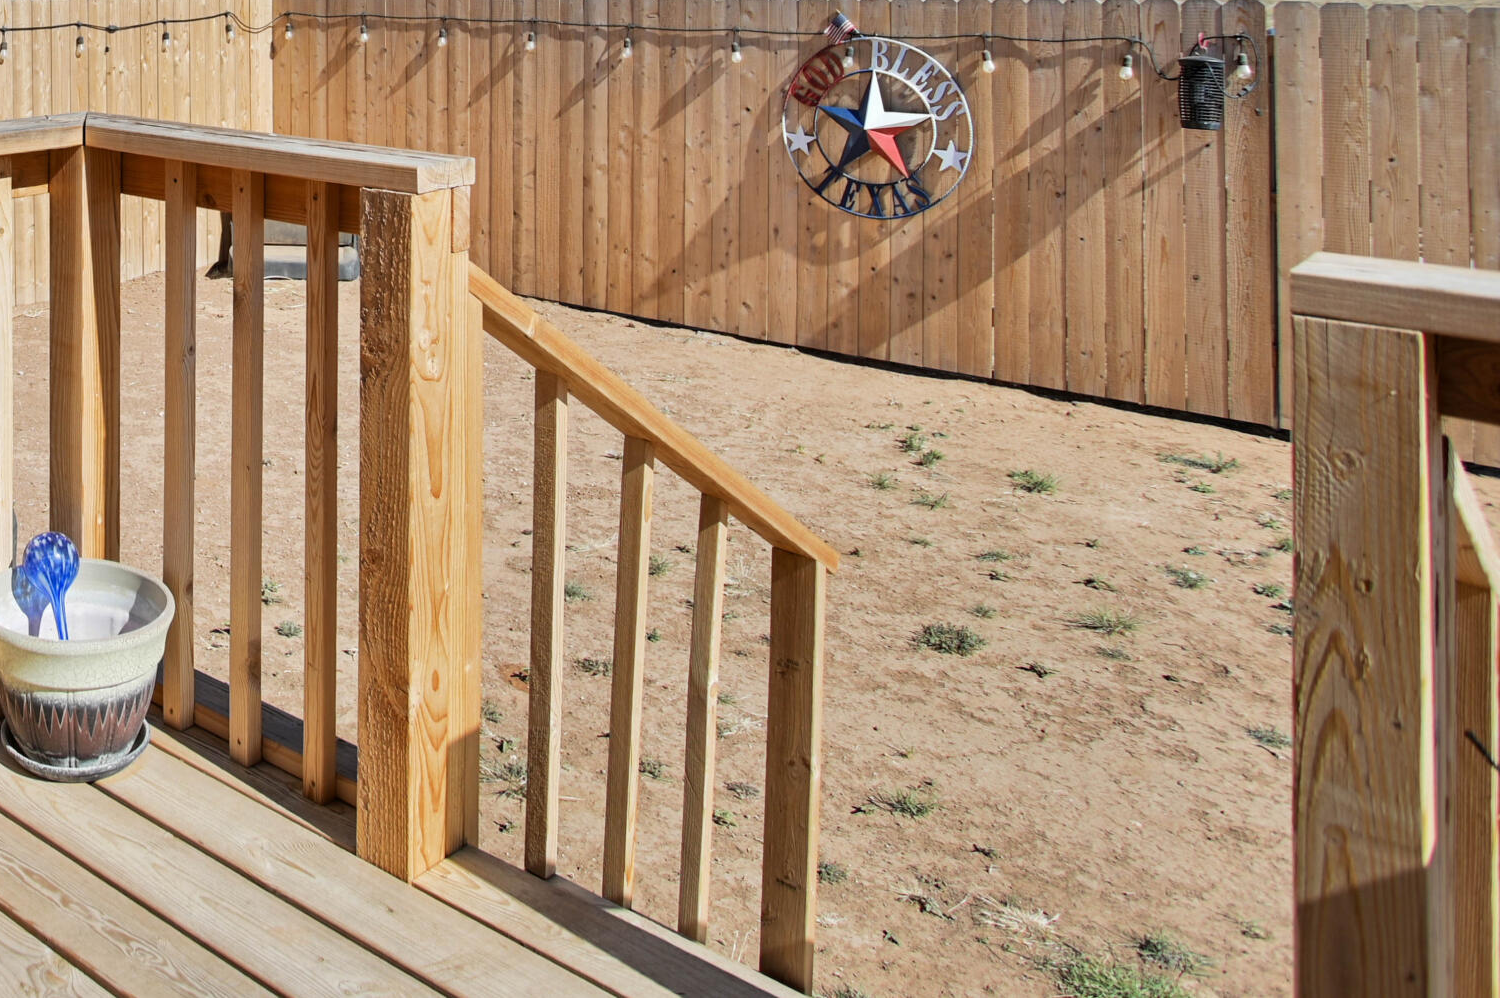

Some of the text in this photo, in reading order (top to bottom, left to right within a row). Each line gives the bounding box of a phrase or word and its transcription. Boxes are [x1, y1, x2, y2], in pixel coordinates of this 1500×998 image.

[788, 39, 966, 121] GOD BLESS
[814, 164, 931, 217] TEXAS
